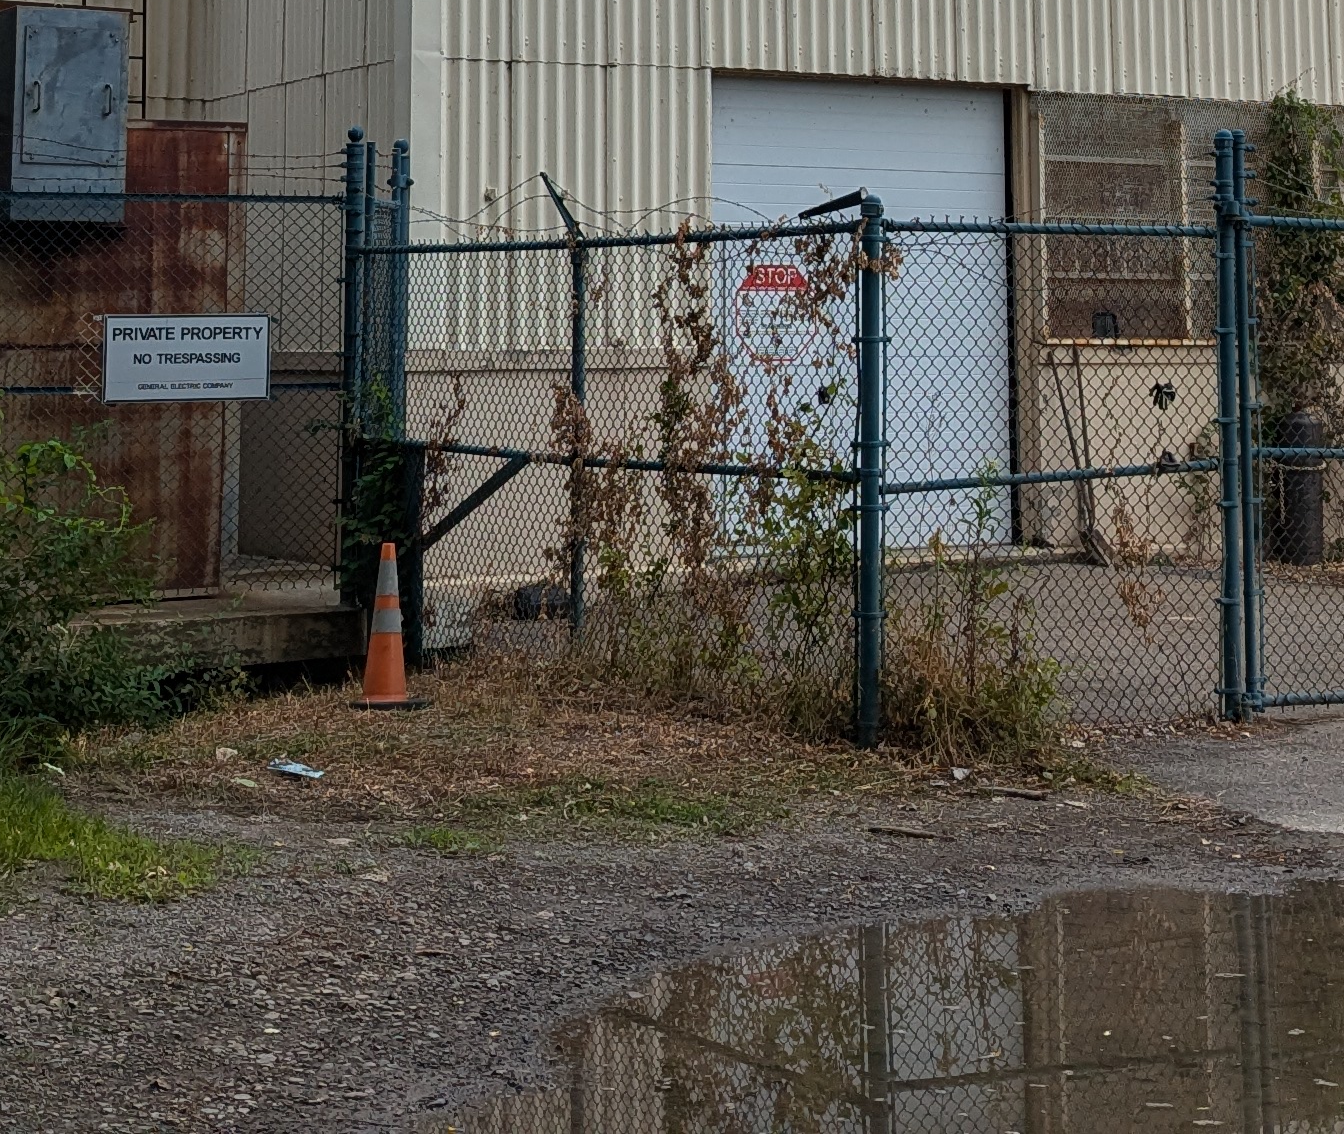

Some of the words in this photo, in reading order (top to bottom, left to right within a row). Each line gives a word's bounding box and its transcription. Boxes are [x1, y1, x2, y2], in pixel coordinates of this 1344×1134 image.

[756, 268, 797, 284] STOP
[112, 327, 175, 341] PRIVATE
[180, 326, 264, 341] PROPERTY
[133, 353, 152, 365] NO
[157, 352, 241, 364] TRESPASSING
